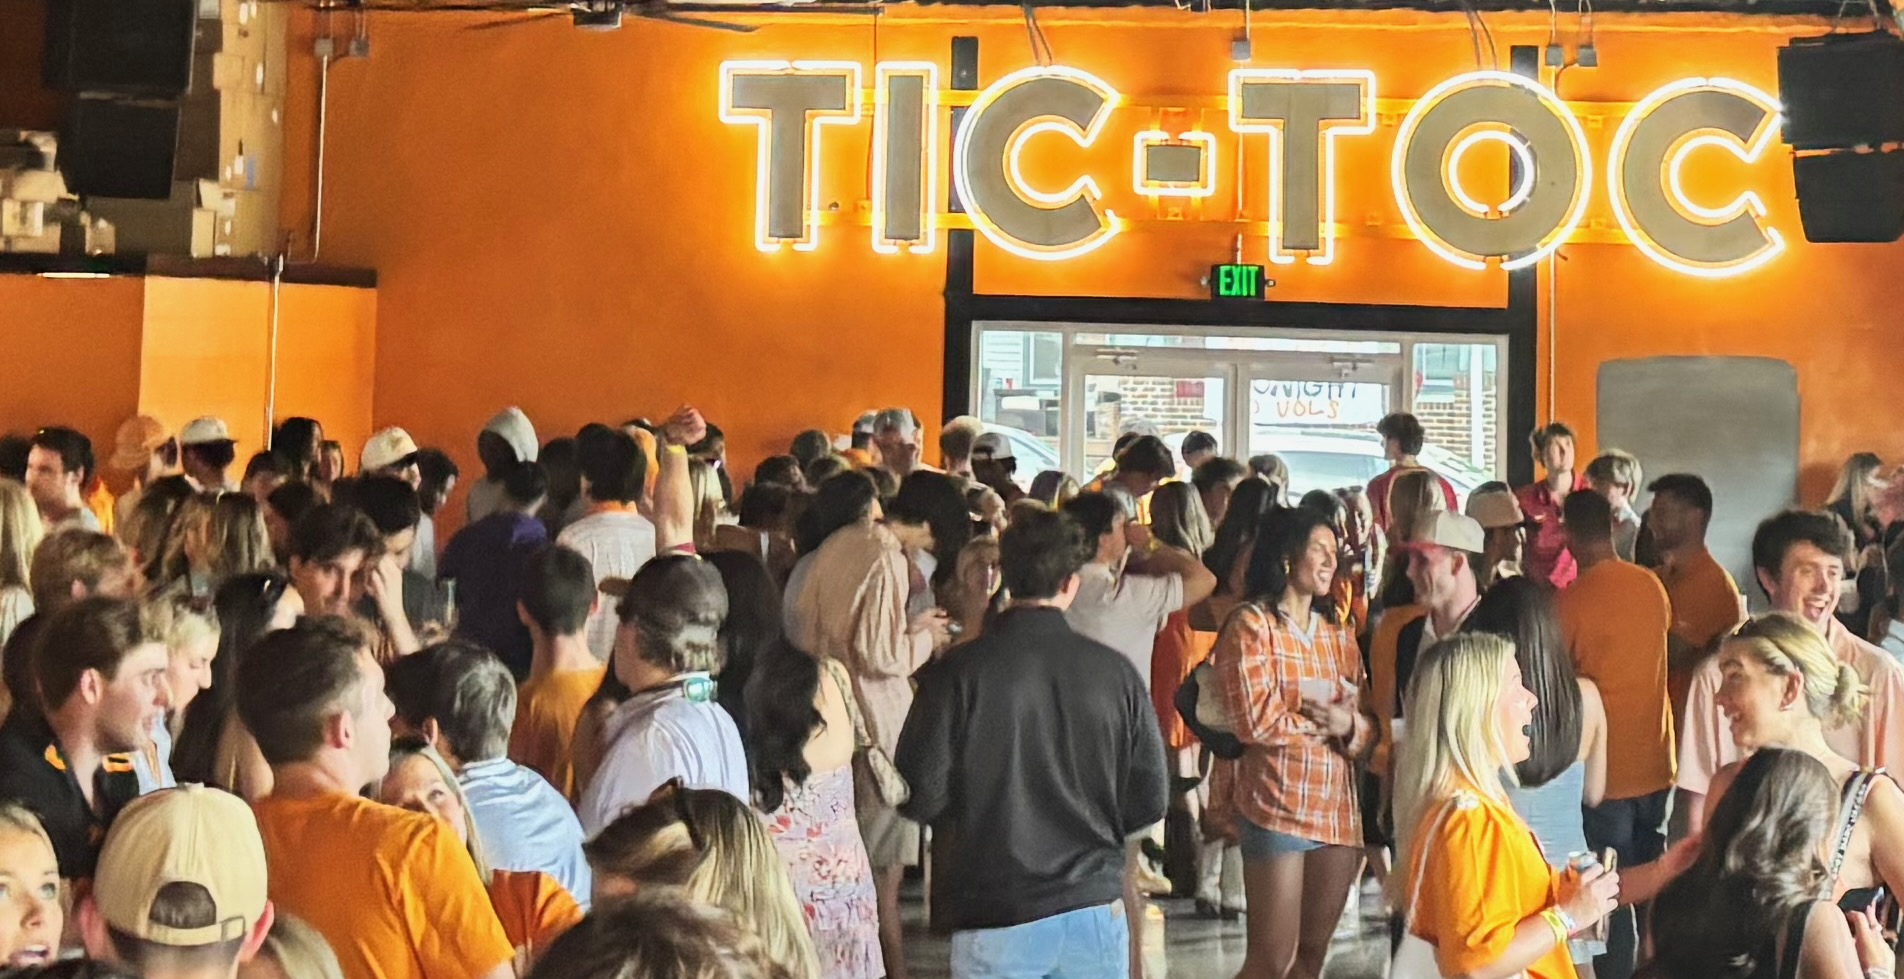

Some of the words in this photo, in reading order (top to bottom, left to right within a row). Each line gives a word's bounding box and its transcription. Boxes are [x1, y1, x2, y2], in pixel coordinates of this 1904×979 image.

[718, 59, 1785, 278] TIC-TOC
[1219, 265, 1259, 297] EXIT
[1276, 400, 1340, 419] VOLS
